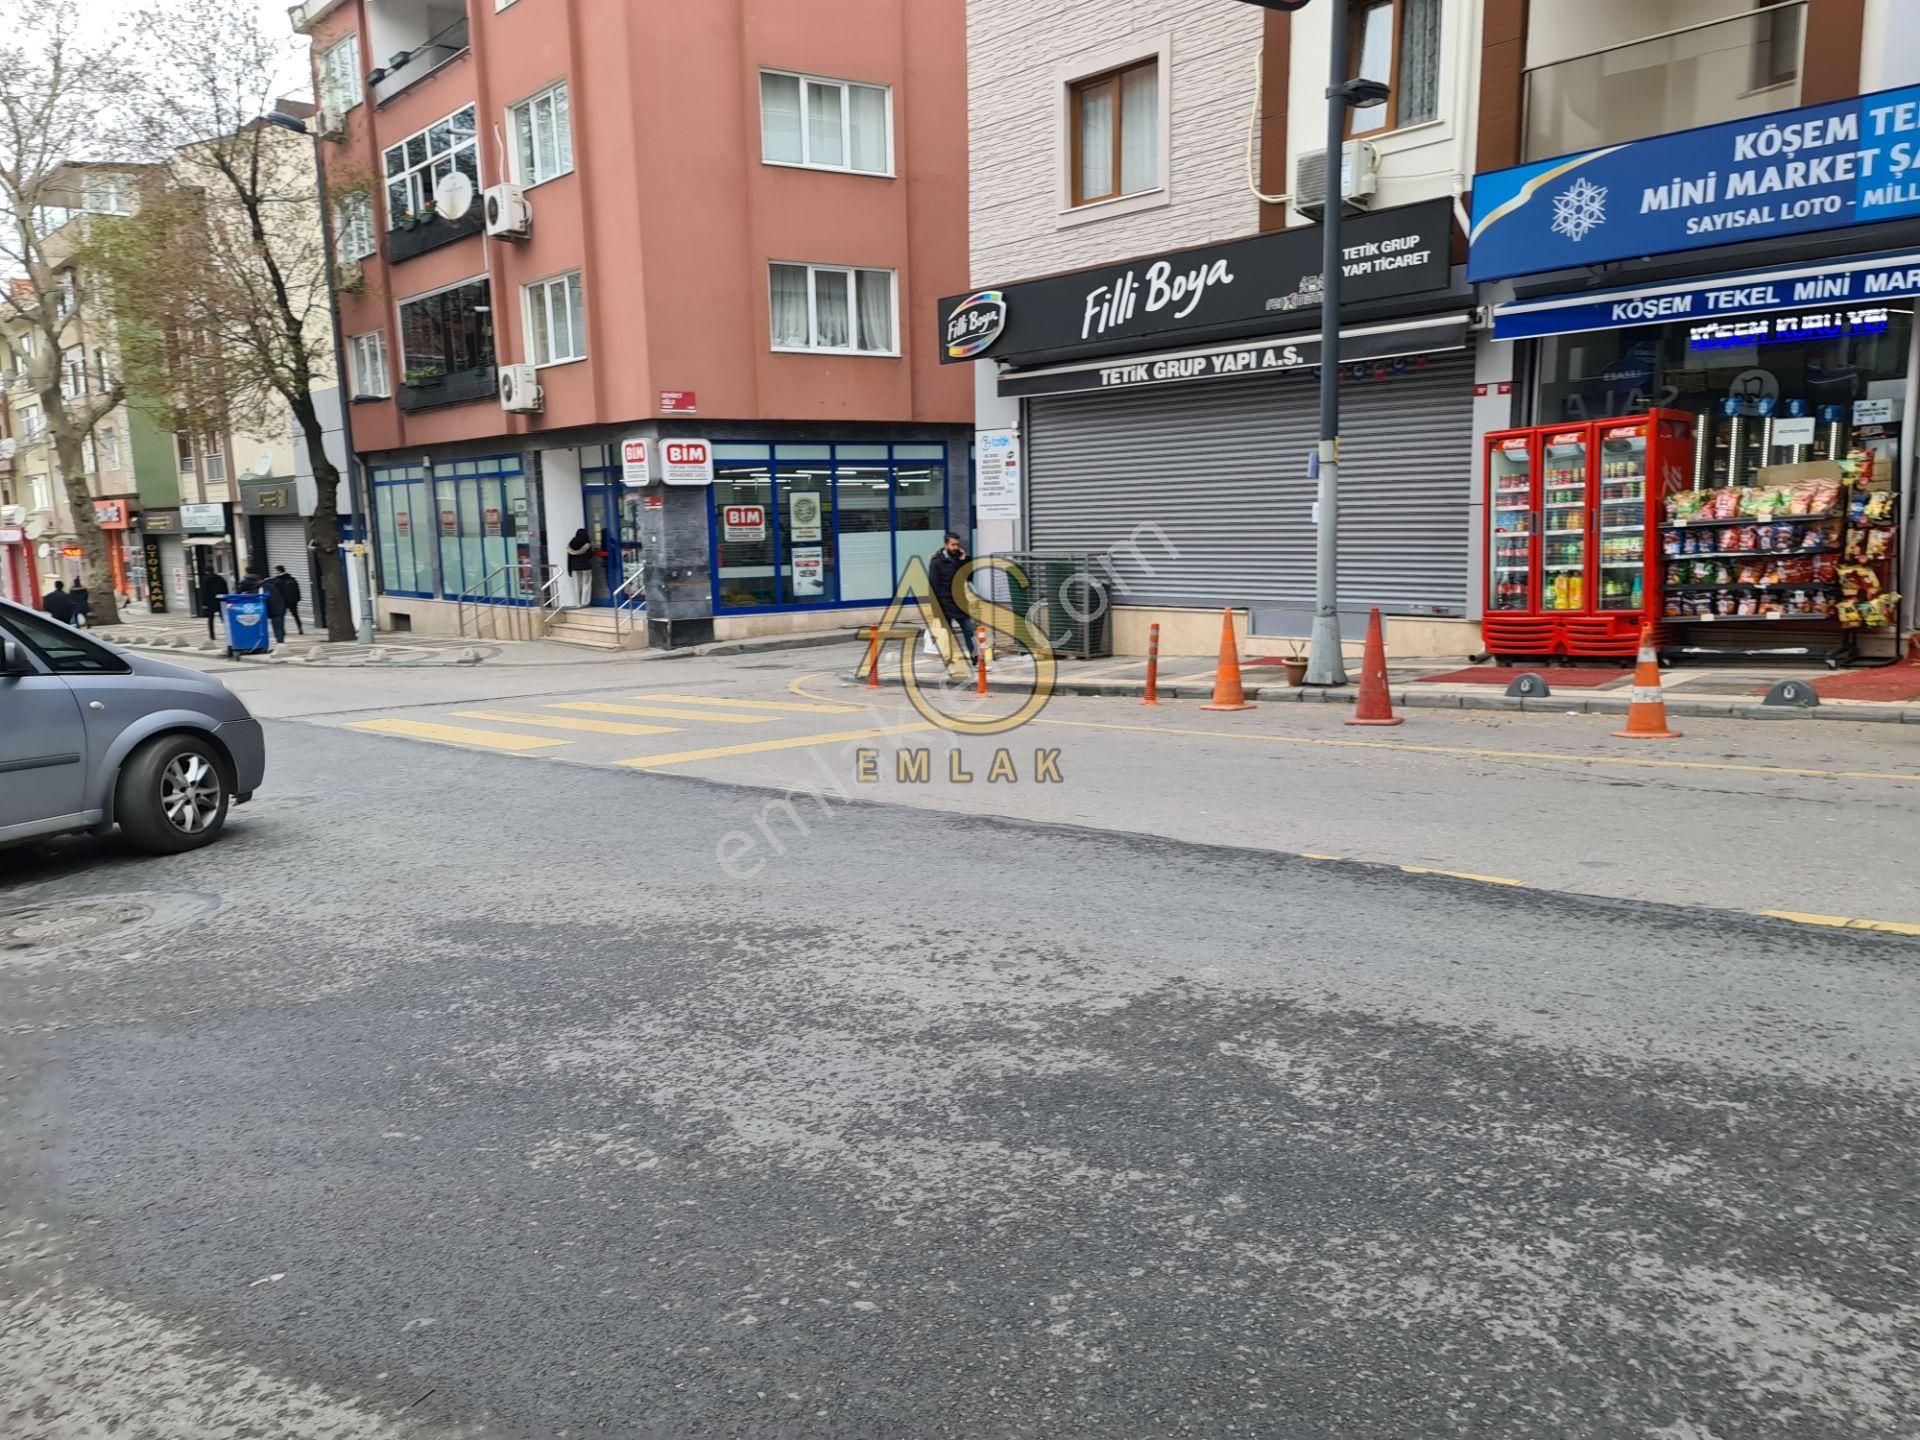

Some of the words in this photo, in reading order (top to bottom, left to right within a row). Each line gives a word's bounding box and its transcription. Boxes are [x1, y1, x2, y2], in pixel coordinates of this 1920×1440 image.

[1733, 113, 1858, 162] KÖŞEM
[1869, 101, 1920, 137] TE
[1640, 171, 1717, 214] MİNİ
[1725, 148, 1881, 201] MARKET
[1686, 205, 1776, 235] SAYISAL
[1780, 195, 1842, 222] LOTO
[1342, 242, 1380, 260] TETİK
[1380, 235, 1420, 253] GRUP
[1342, 261, 1372, 277] YAPI
[1373, 250, 1431, 272] TİCARET
[1081, 270, 1140, 340] Filli
[1145, 260, 1235, 319] Boya
[1612, 294, 1693, 321] KÖŞEM
[1705, 286, 1780, 310] TEKEL
[1794, 273, 1850, 301] MİNİ
[947, 314, 968, 341] Filli
[968, 310, 999, 333] Boya
[1099, 363, 1150, 386] TETİK
[1153, 357, 1207, 379] GRUP
[1211, 350, 1257, 374] YAPI
